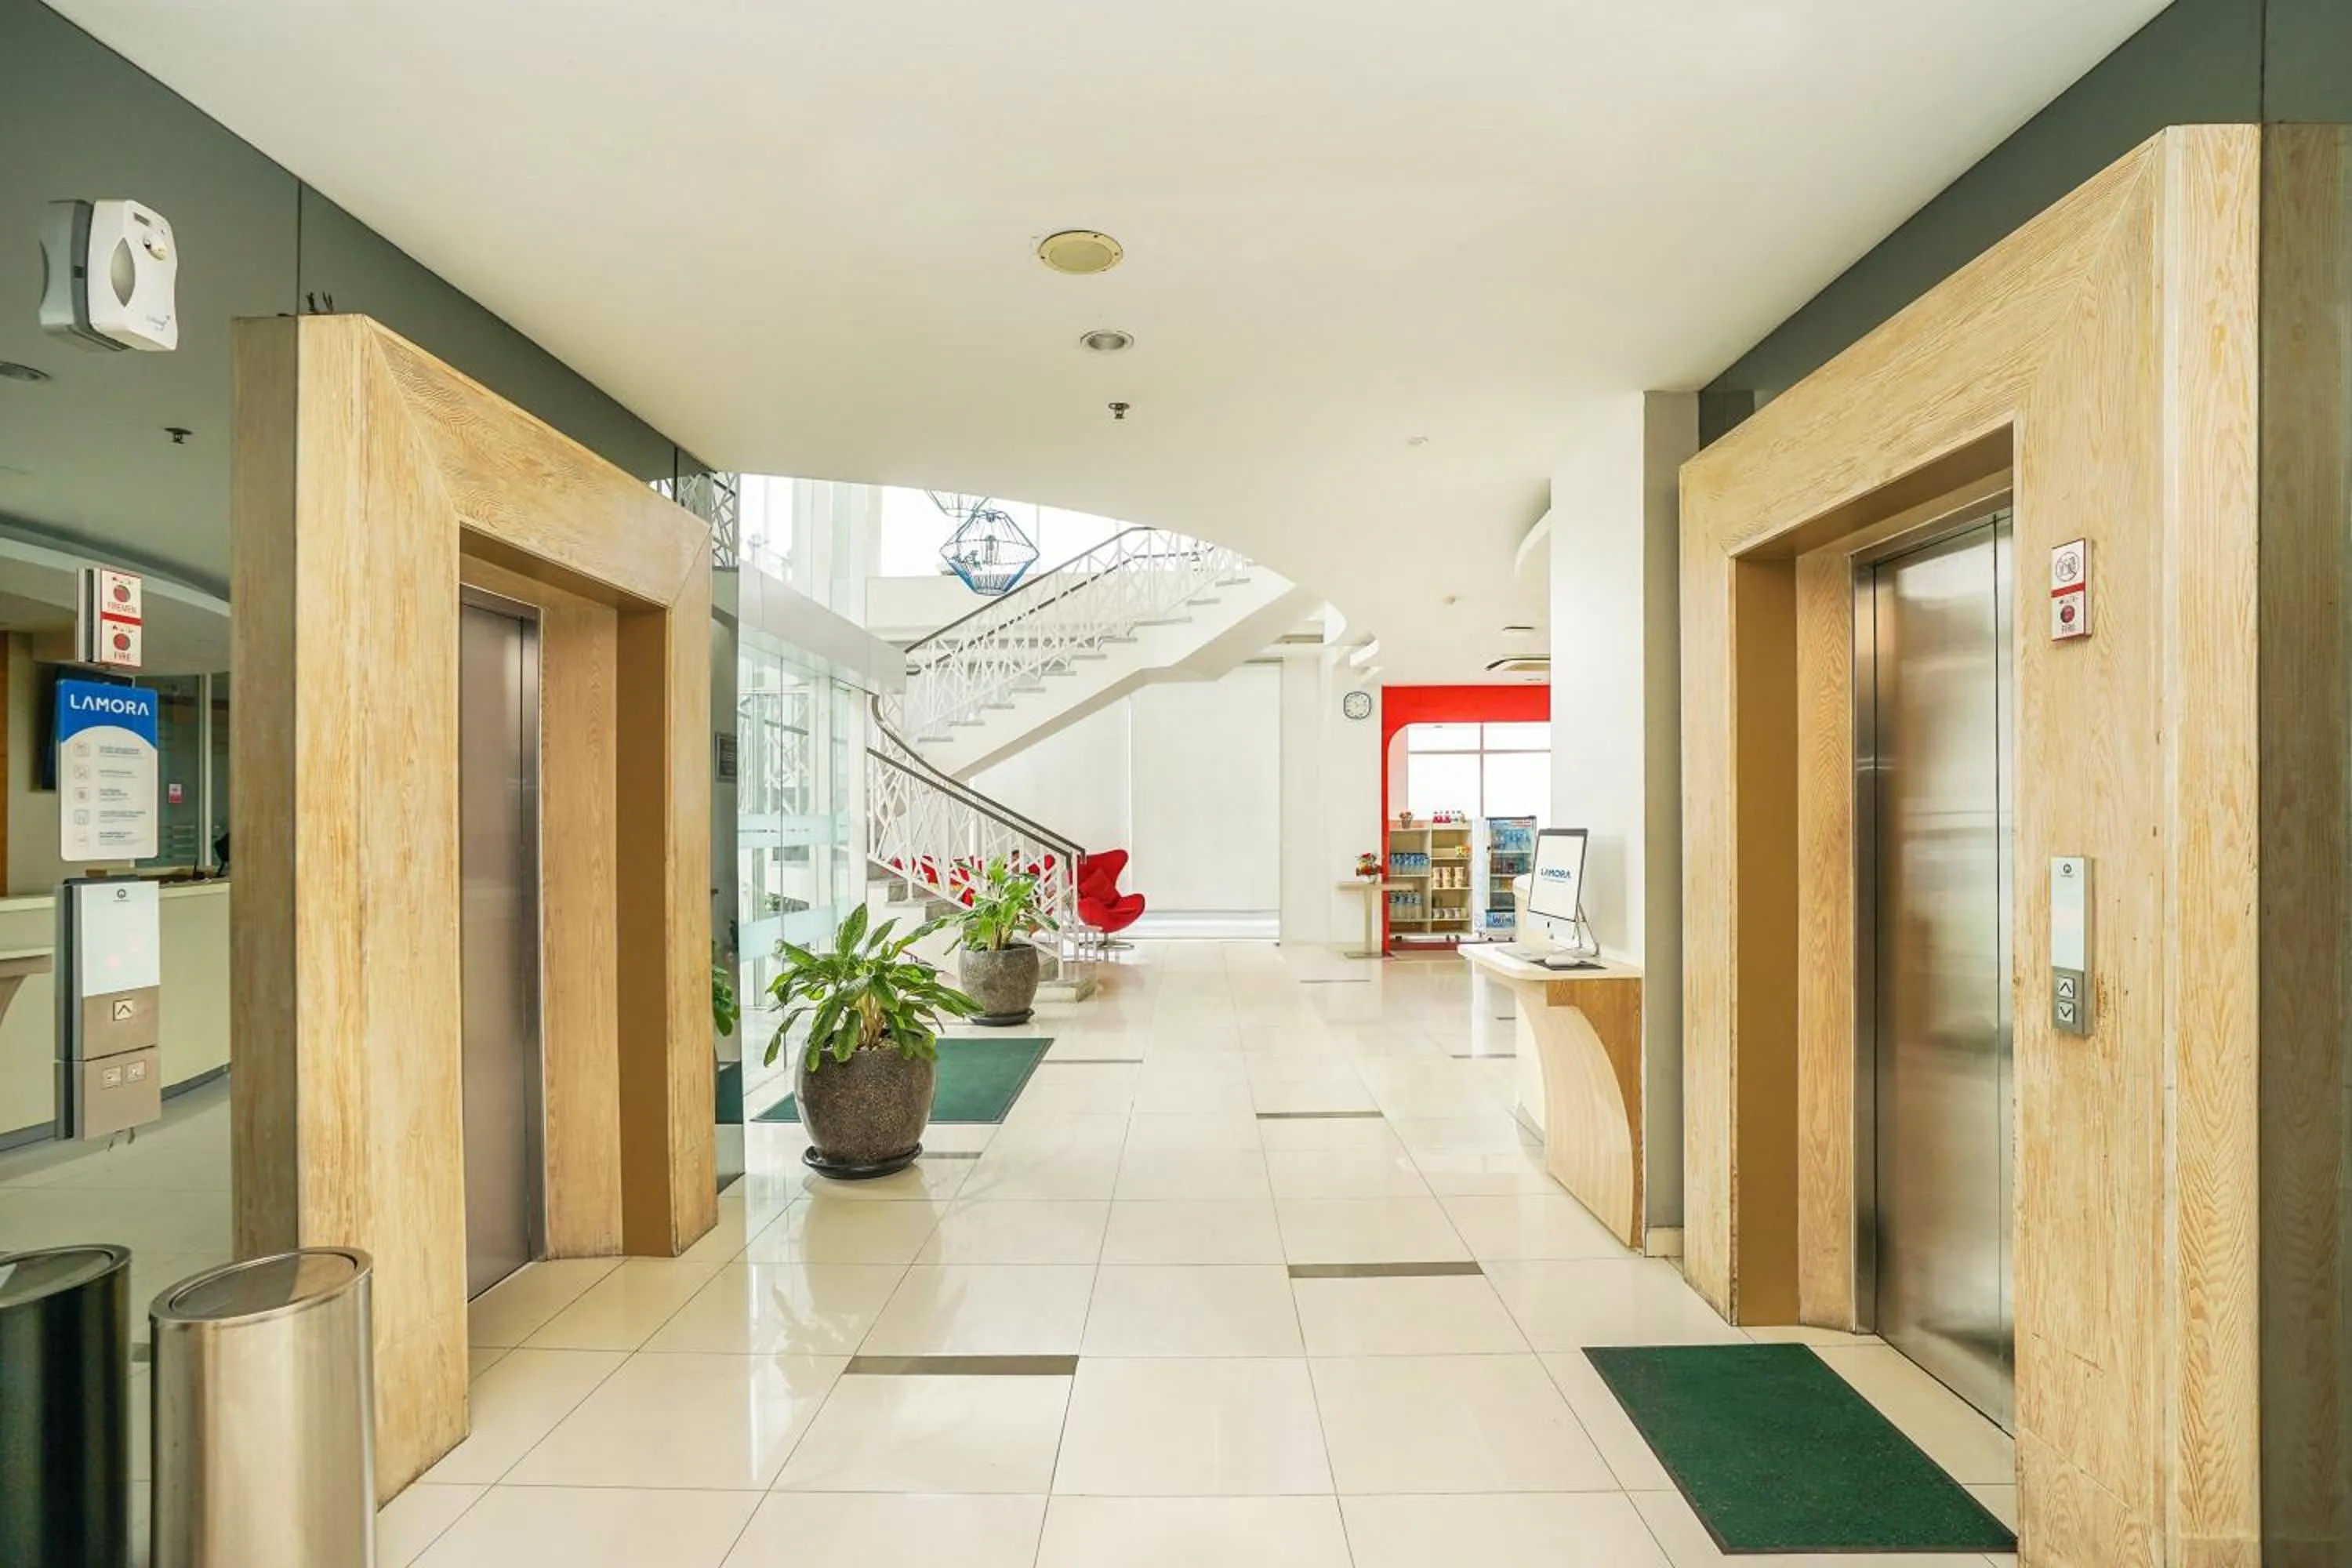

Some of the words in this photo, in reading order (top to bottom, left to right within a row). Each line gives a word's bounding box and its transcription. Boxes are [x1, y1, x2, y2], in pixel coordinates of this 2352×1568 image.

[114, 652, 132, 662] FIRE
[70, 694, 149, 716] LAMORA
[1541, 868, 1571, 879] LAMORA
